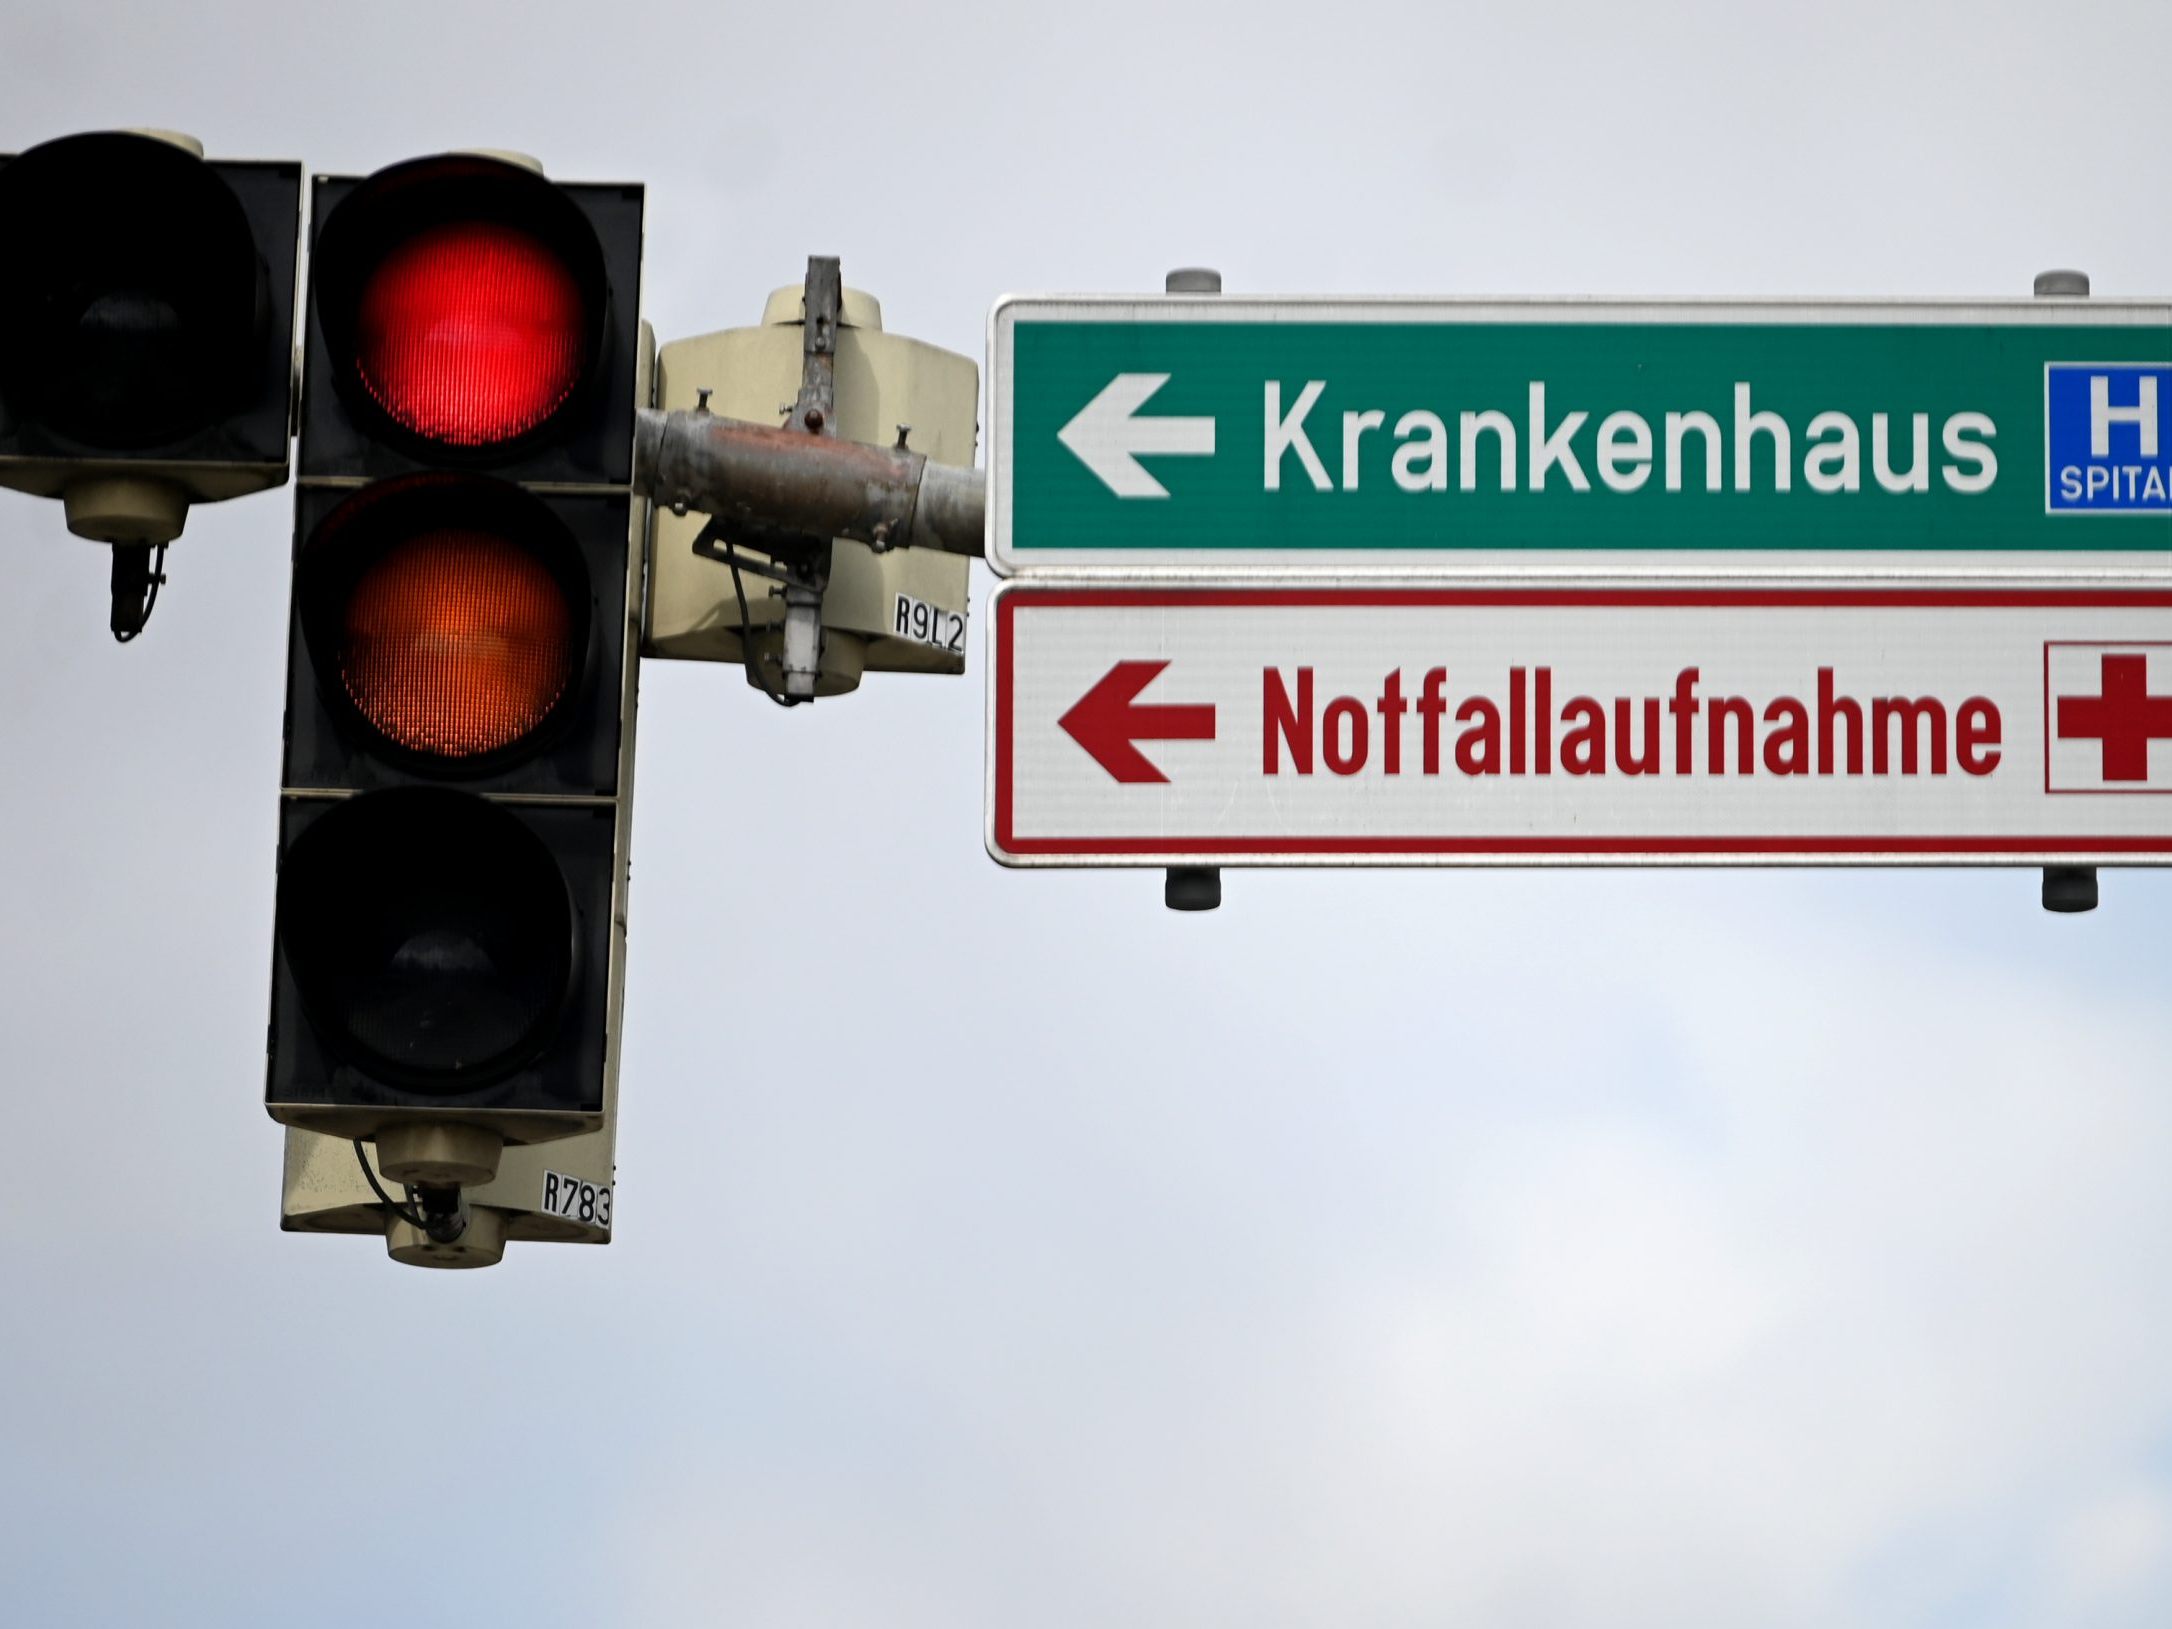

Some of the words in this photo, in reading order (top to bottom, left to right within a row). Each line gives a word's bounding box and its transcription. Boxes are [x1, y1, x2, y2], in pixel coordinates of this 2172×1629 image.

[1264, 381, 1998, 494] Krankenhaus
[2090, 376, 2158, 457] H
[2060, 464, 2172, 501] SPITA
[1263, 667, 2001, 778] Notfallaufnahme
[544, 1173, 611, 1226] R783
